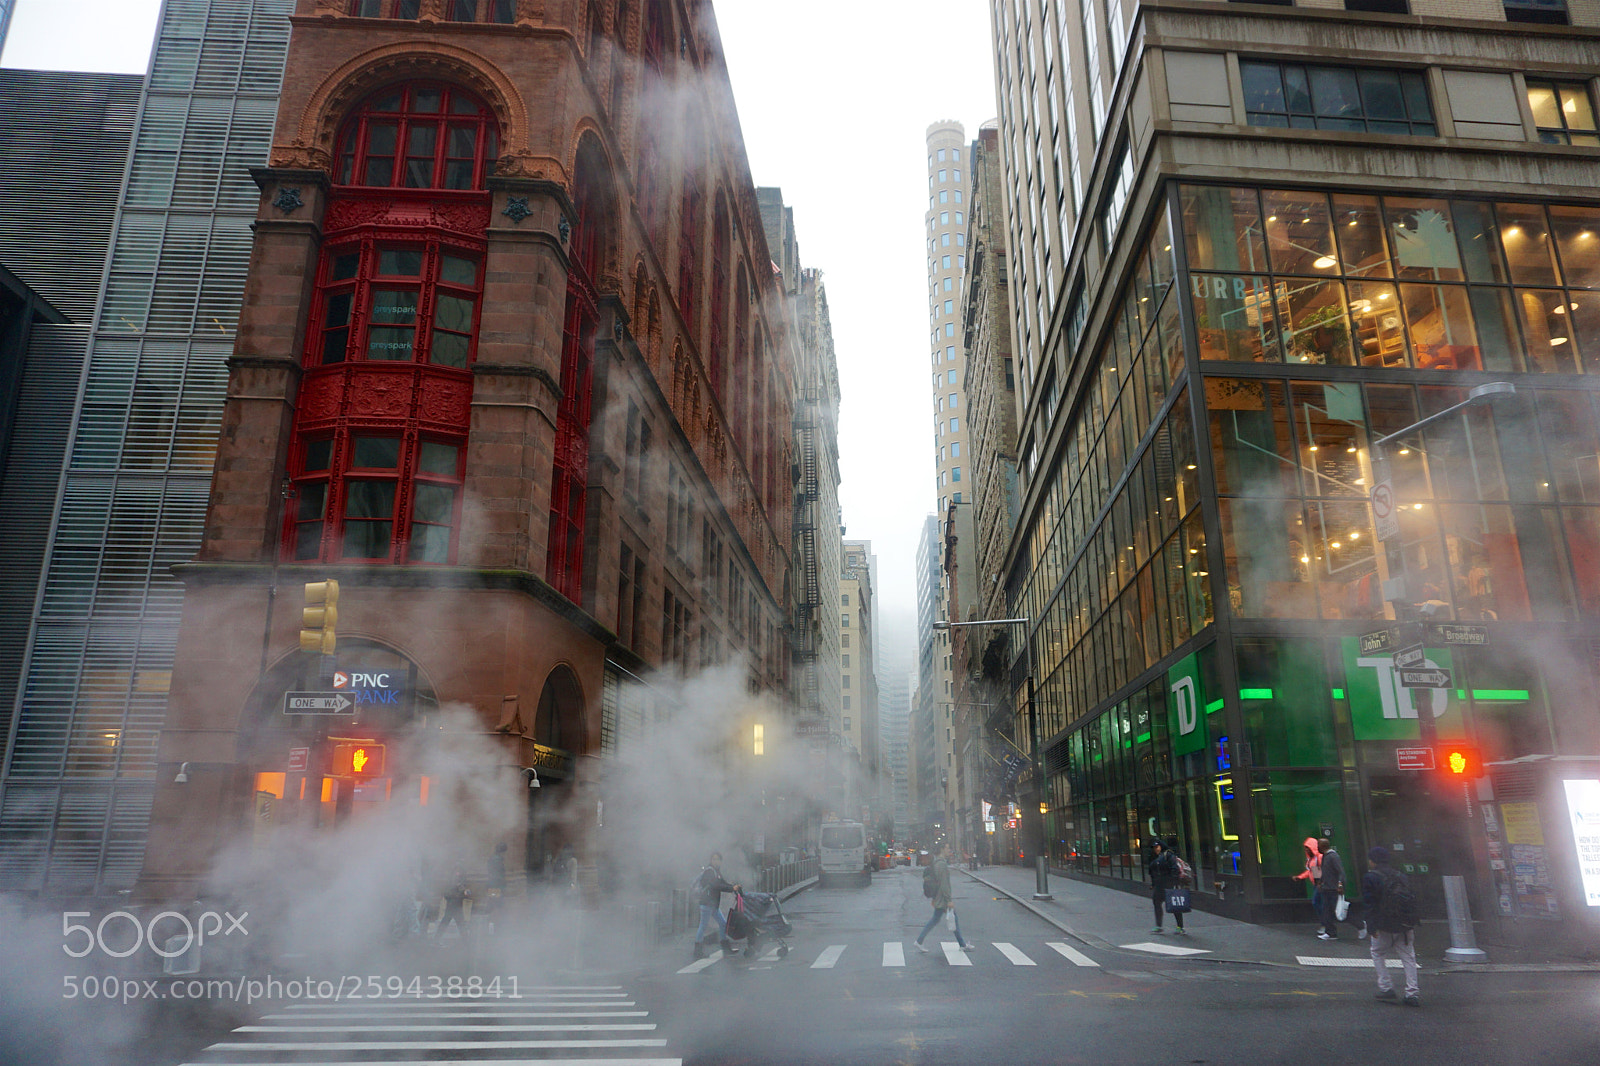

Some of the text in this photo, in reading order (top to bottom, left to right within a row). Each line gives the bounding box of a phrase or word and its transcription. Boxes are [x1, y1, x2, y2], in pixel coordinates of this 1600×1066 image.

[373, 304, 416, 314] greyspark
[370, 341, 412, 350] greyspark
[1446, 630, 1485, 642] Broadway
[1363, 638, 1382, 651] John
[351, 673, 390, 688] PNC
[1407, 673, 1444, 683] ONE WAY
[1357, 658, 1448, 719] TD
[295, 698, 345, 708] ONE WAY
[1171, 675, 1197, 736] TD
[1171, 896, 1185, 906] GAP
